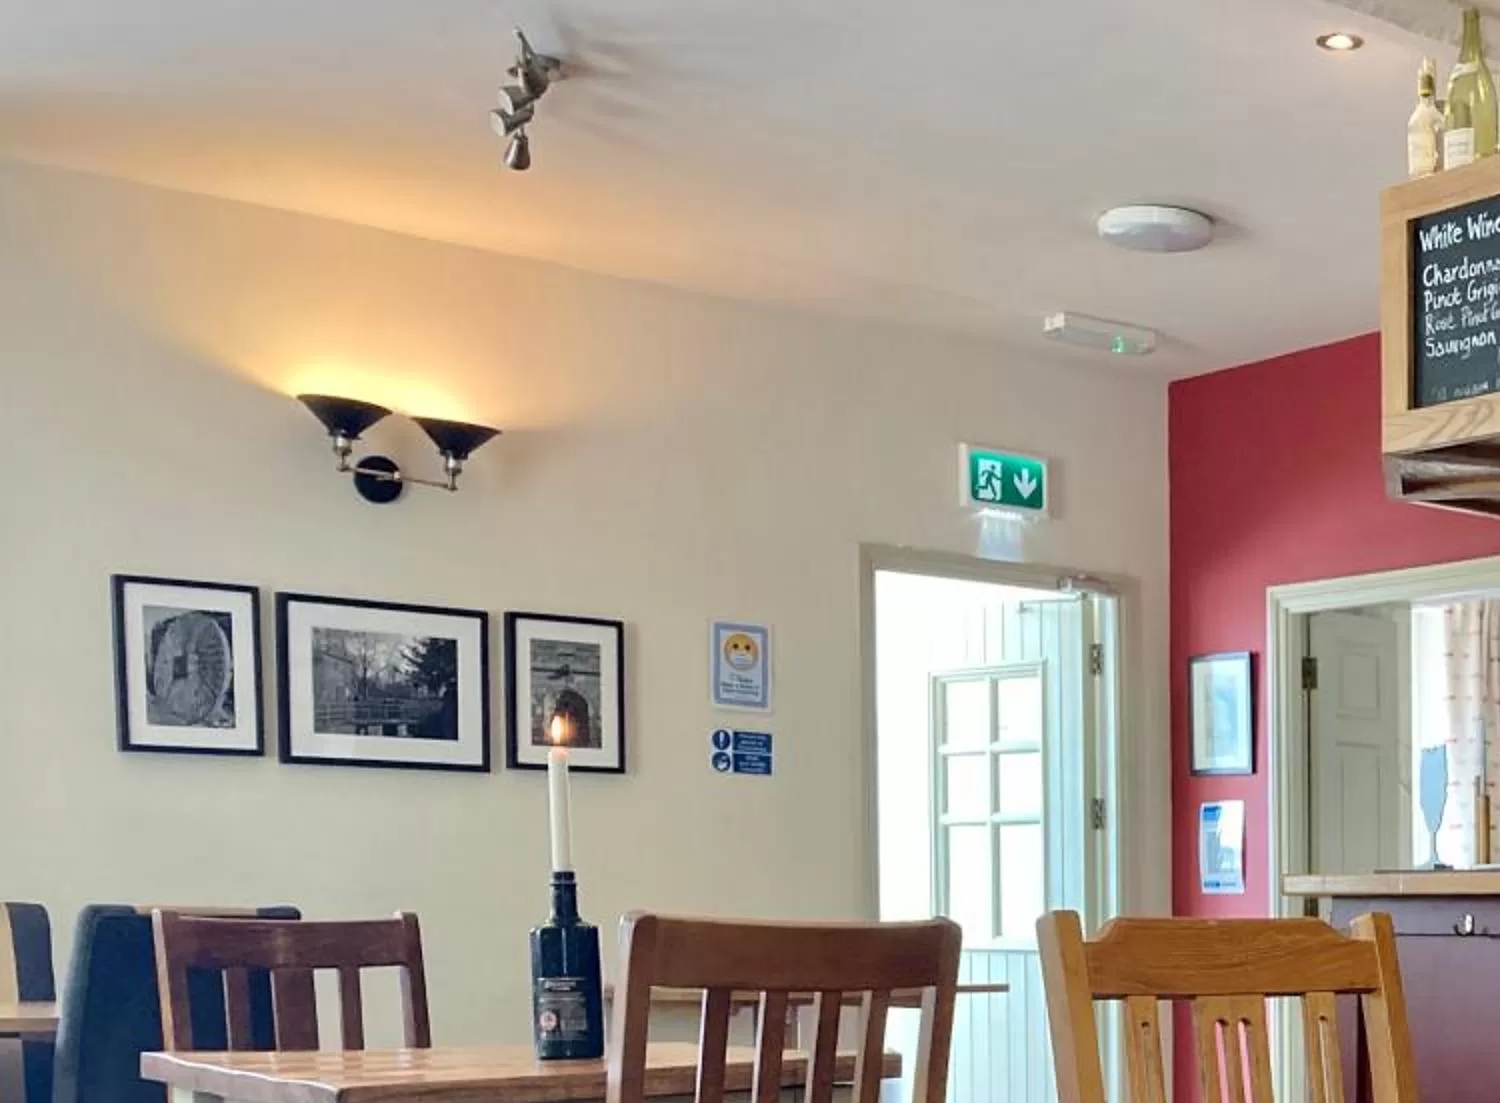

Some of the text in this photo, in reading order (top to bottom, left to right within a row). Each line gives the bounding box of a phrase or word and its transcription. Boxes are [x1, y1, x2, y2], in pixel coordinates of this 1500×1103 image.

[1420, 221, 1463, 252] White
[1424, 287, 1462, 312] Pinot
[1425, 331, 1497, 360] Sauvignon
